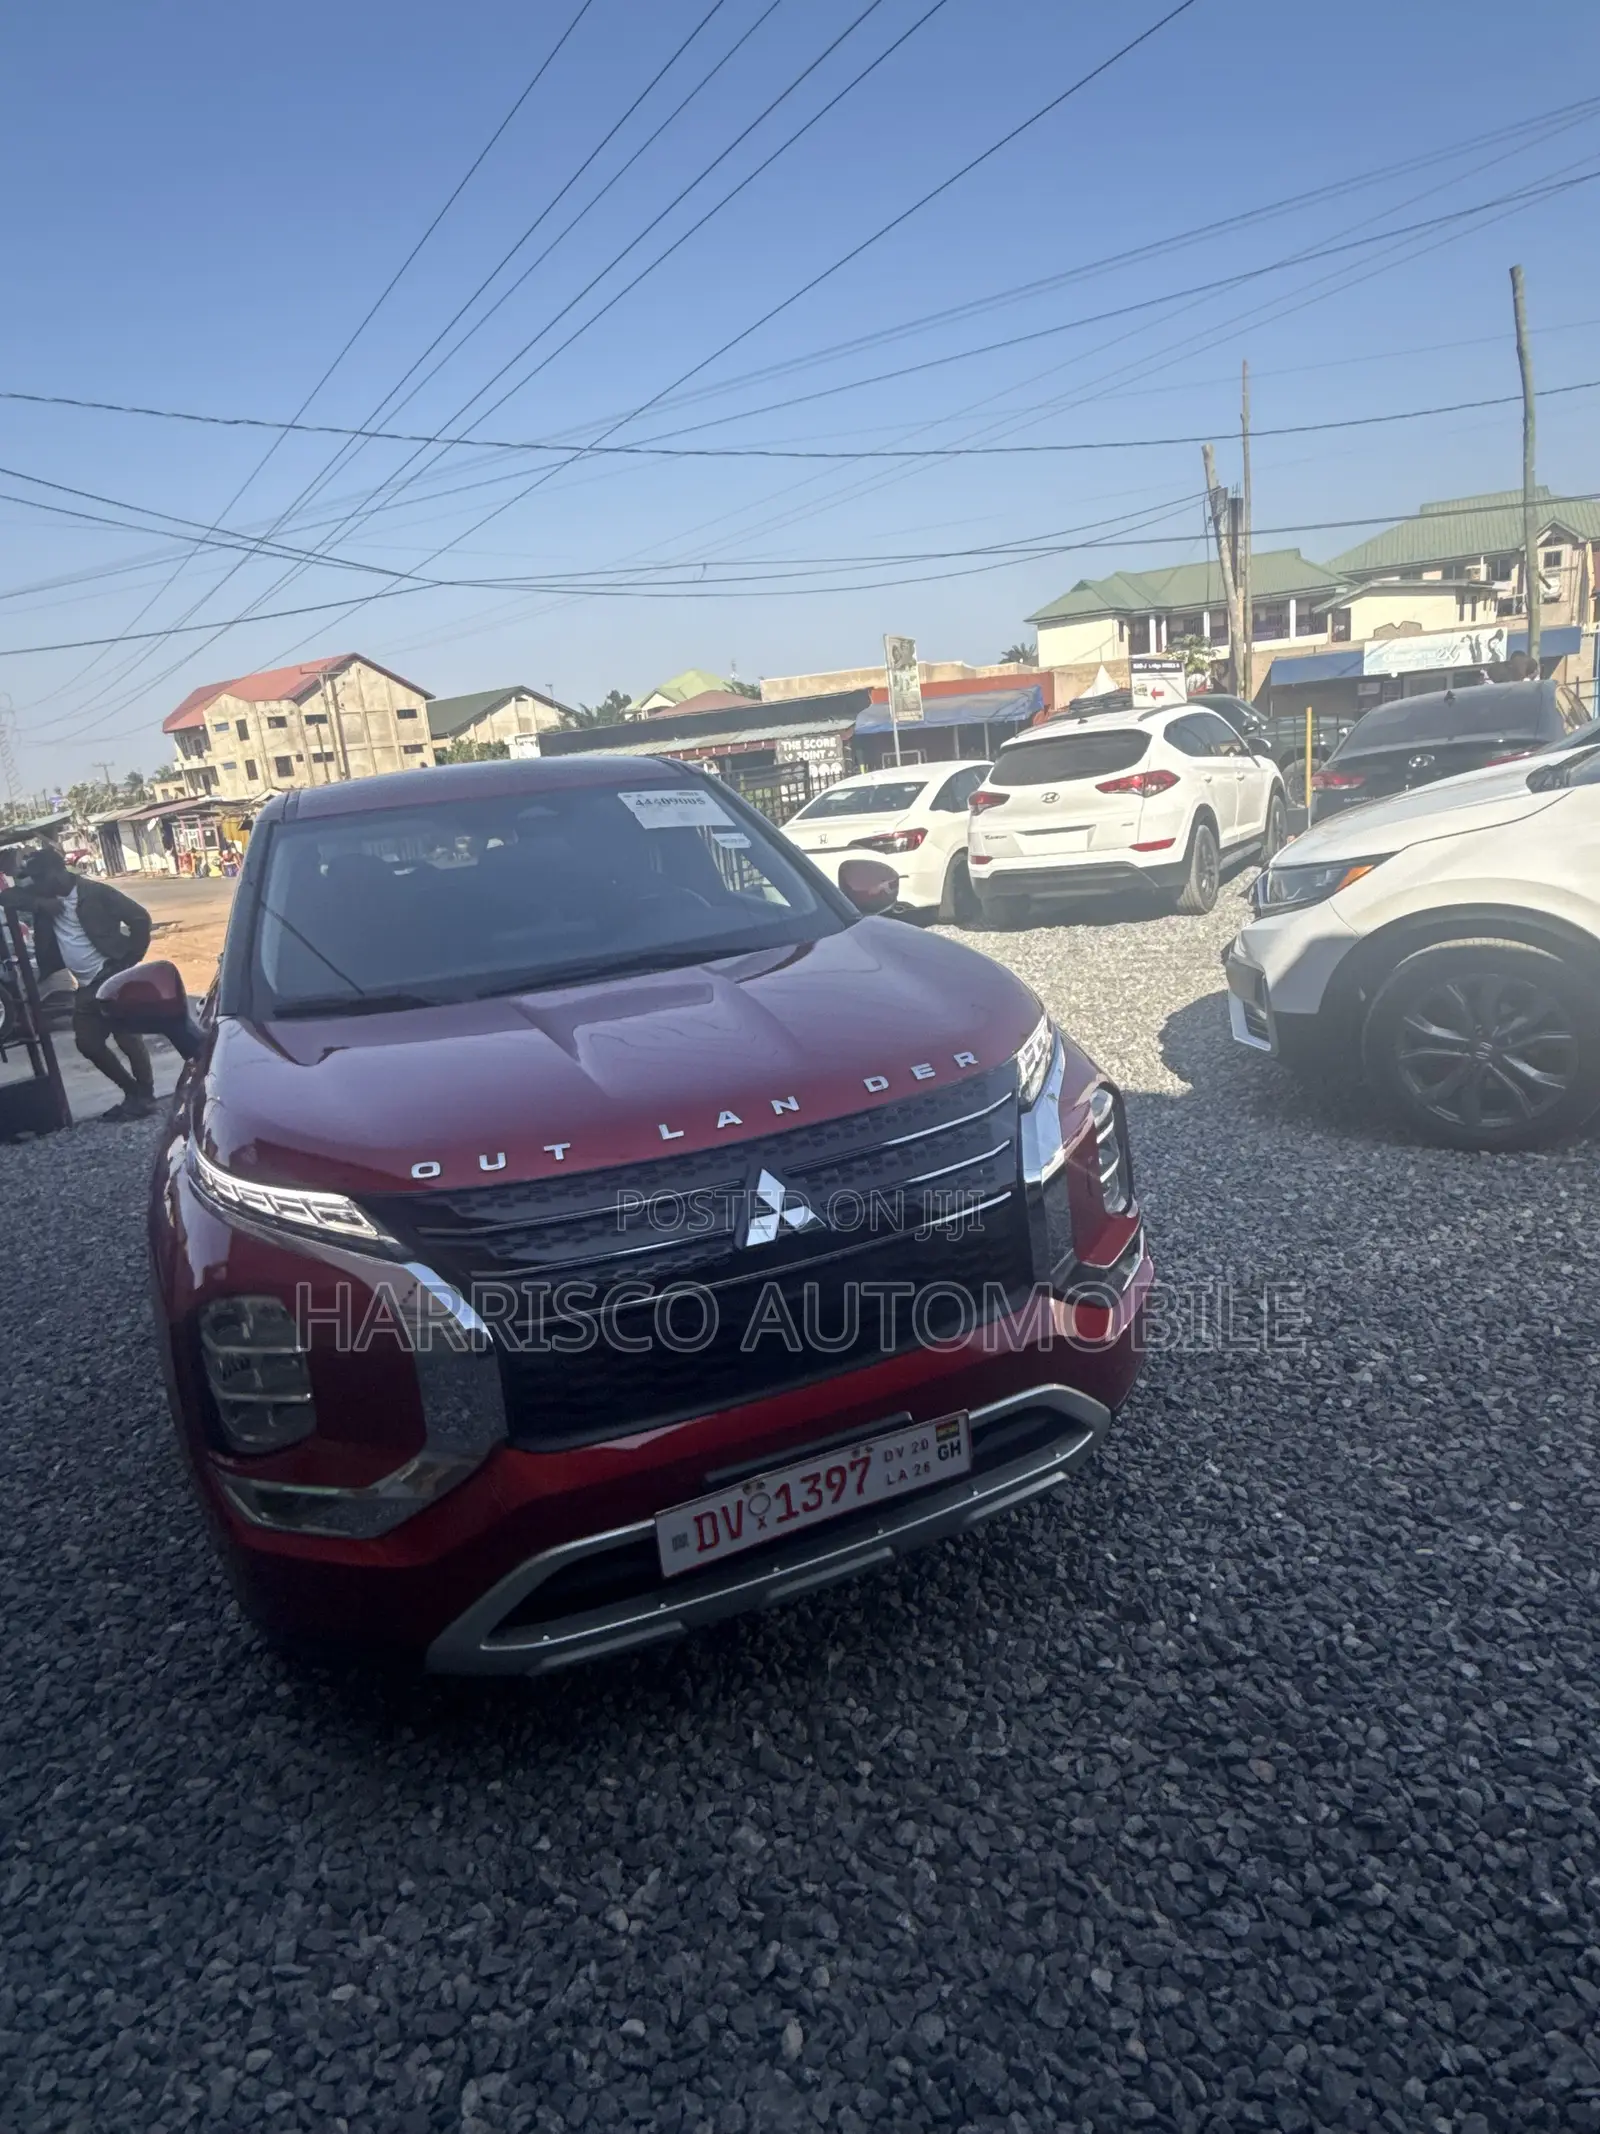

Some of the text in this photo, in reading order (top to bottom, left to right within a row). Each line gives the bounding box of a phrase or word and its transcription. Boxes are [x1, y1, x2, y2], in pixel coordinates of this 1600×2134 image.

[781, 737, 837, 751] THE SCORE
[884, 1438, 929, 1463] DV 20
[937, 1439, 962, 1461] GH
[885, 1469, 908, 1485] LA
[693, 1498, 744, 1552] DV
[775, 1456, 872, 1524] 1397
